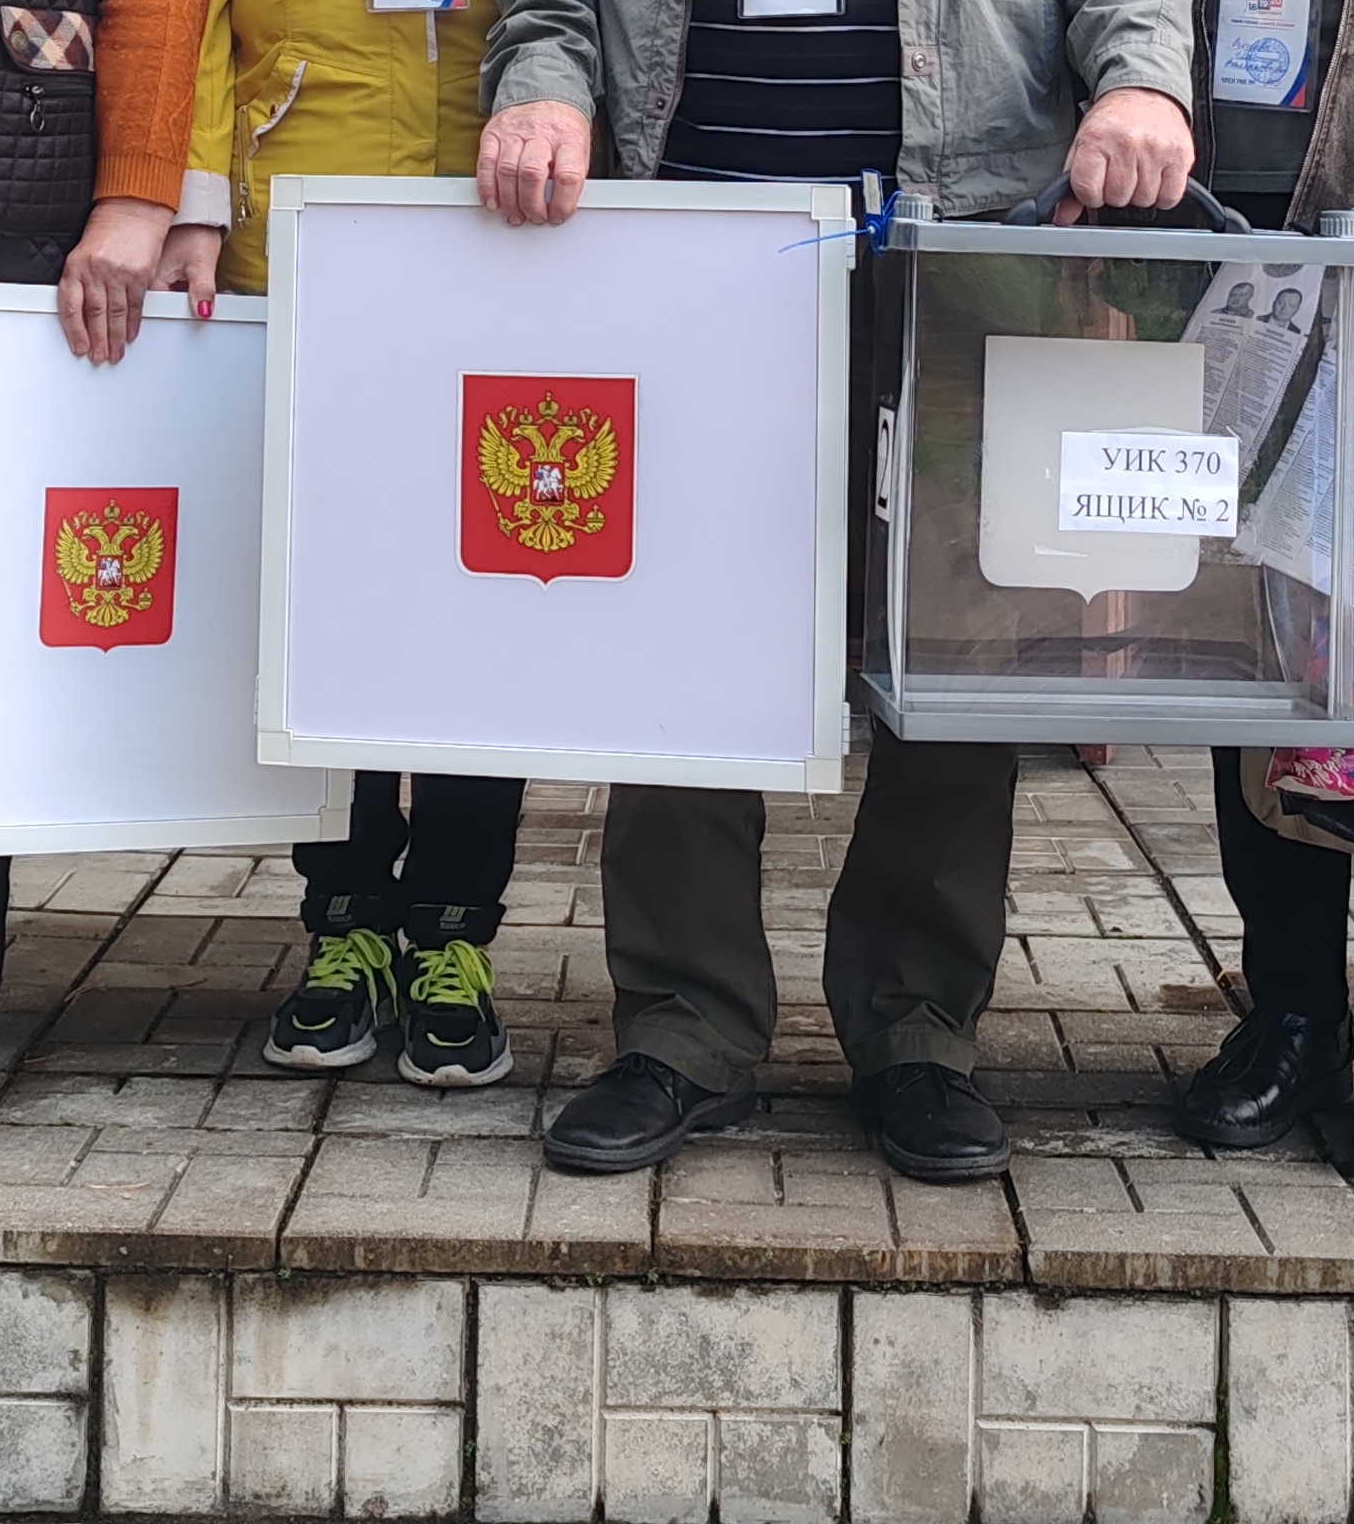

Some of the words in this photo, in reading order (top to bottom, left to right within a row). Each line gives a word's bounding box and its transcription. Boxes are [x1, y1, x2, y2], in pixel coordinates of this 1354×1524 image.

[877, 418, 890, 510] 2
[1101, 446, 1166, 474] УИК
[1174, 450, 1222, 476] 370
[1071, 493, 1170, 525] ЯЩИК
[1176, 497, 1208, 523] №
[1215, 498, 1231, 523] 2
